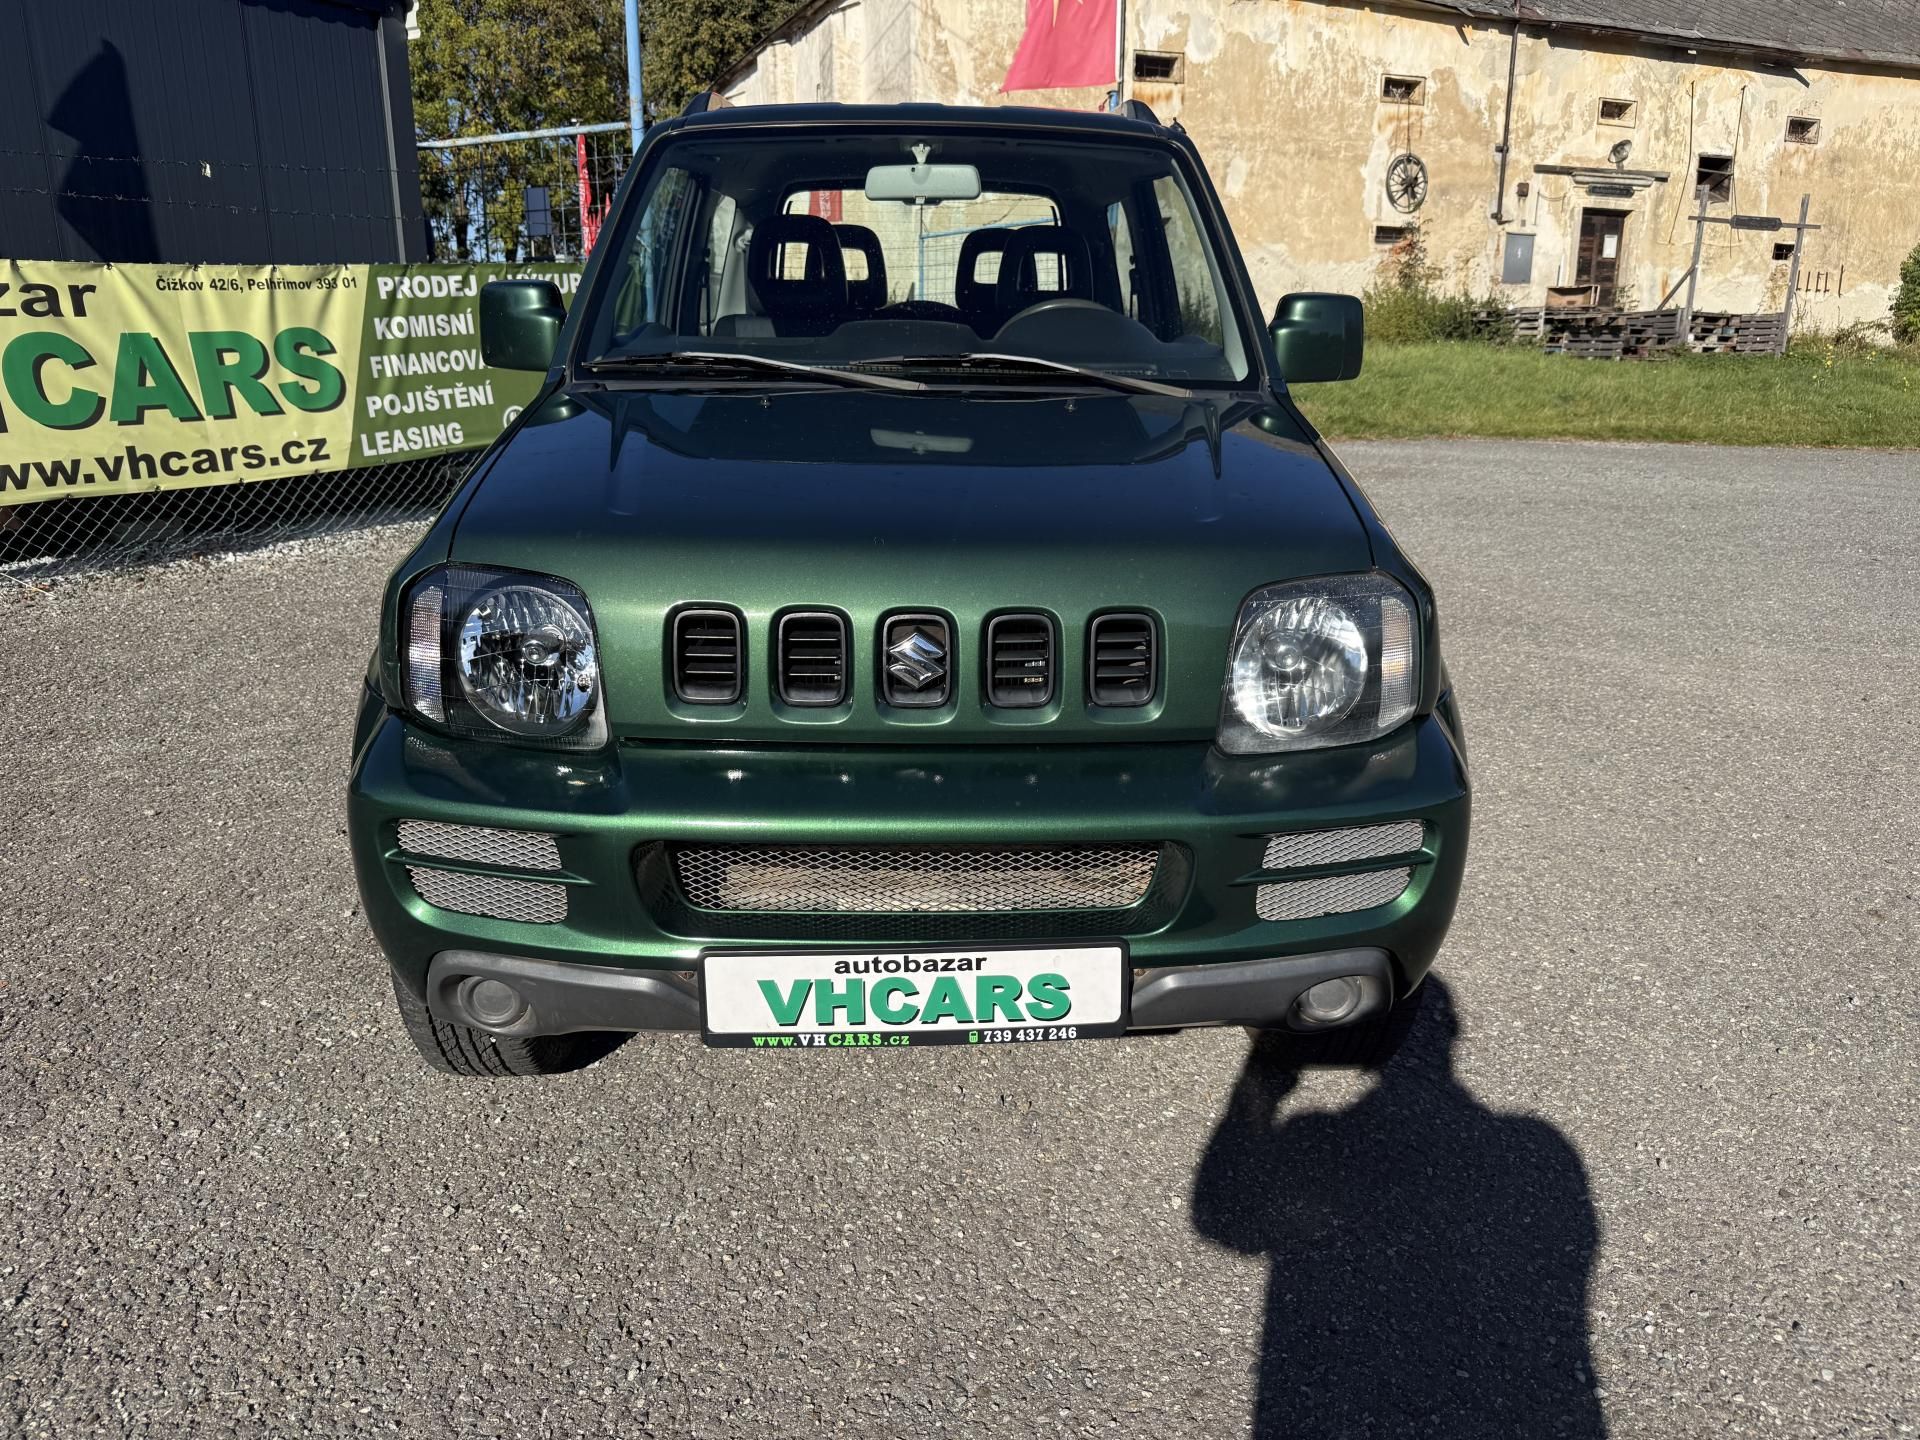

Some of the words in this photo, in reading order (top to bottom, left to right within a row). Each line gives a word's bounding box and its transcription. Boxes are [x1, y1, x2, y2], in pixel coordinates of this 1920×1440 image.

[156, 275, 204, 291] Čížkov
[209, 278, 244, 293] 42/6,
[247, 277, 312, 290] Pelhřimov
[316, 277, 338, 290] 393
[342, 277, 358, 289] 01
[377, 274, 478, 300] PRODEJ
[373, 308, 475, 340] KOMISNÍ
[0, 327, 347, 432] CARS
[365, 379, 495, 418] POJIŠTĚNÍ
[360, 422, 464, 457] LEASING
[834, 955, 987, 974] autobazar
[757, 973, 1072, 1026] VHCARS
[752, 1033, 910, 1046] www.VHCARS.cz
[984, 1030, 1012, 1042] 739
[1016, 1029, 1044, 1040] 437
[1048, 1027, 1077, 1039] 246
